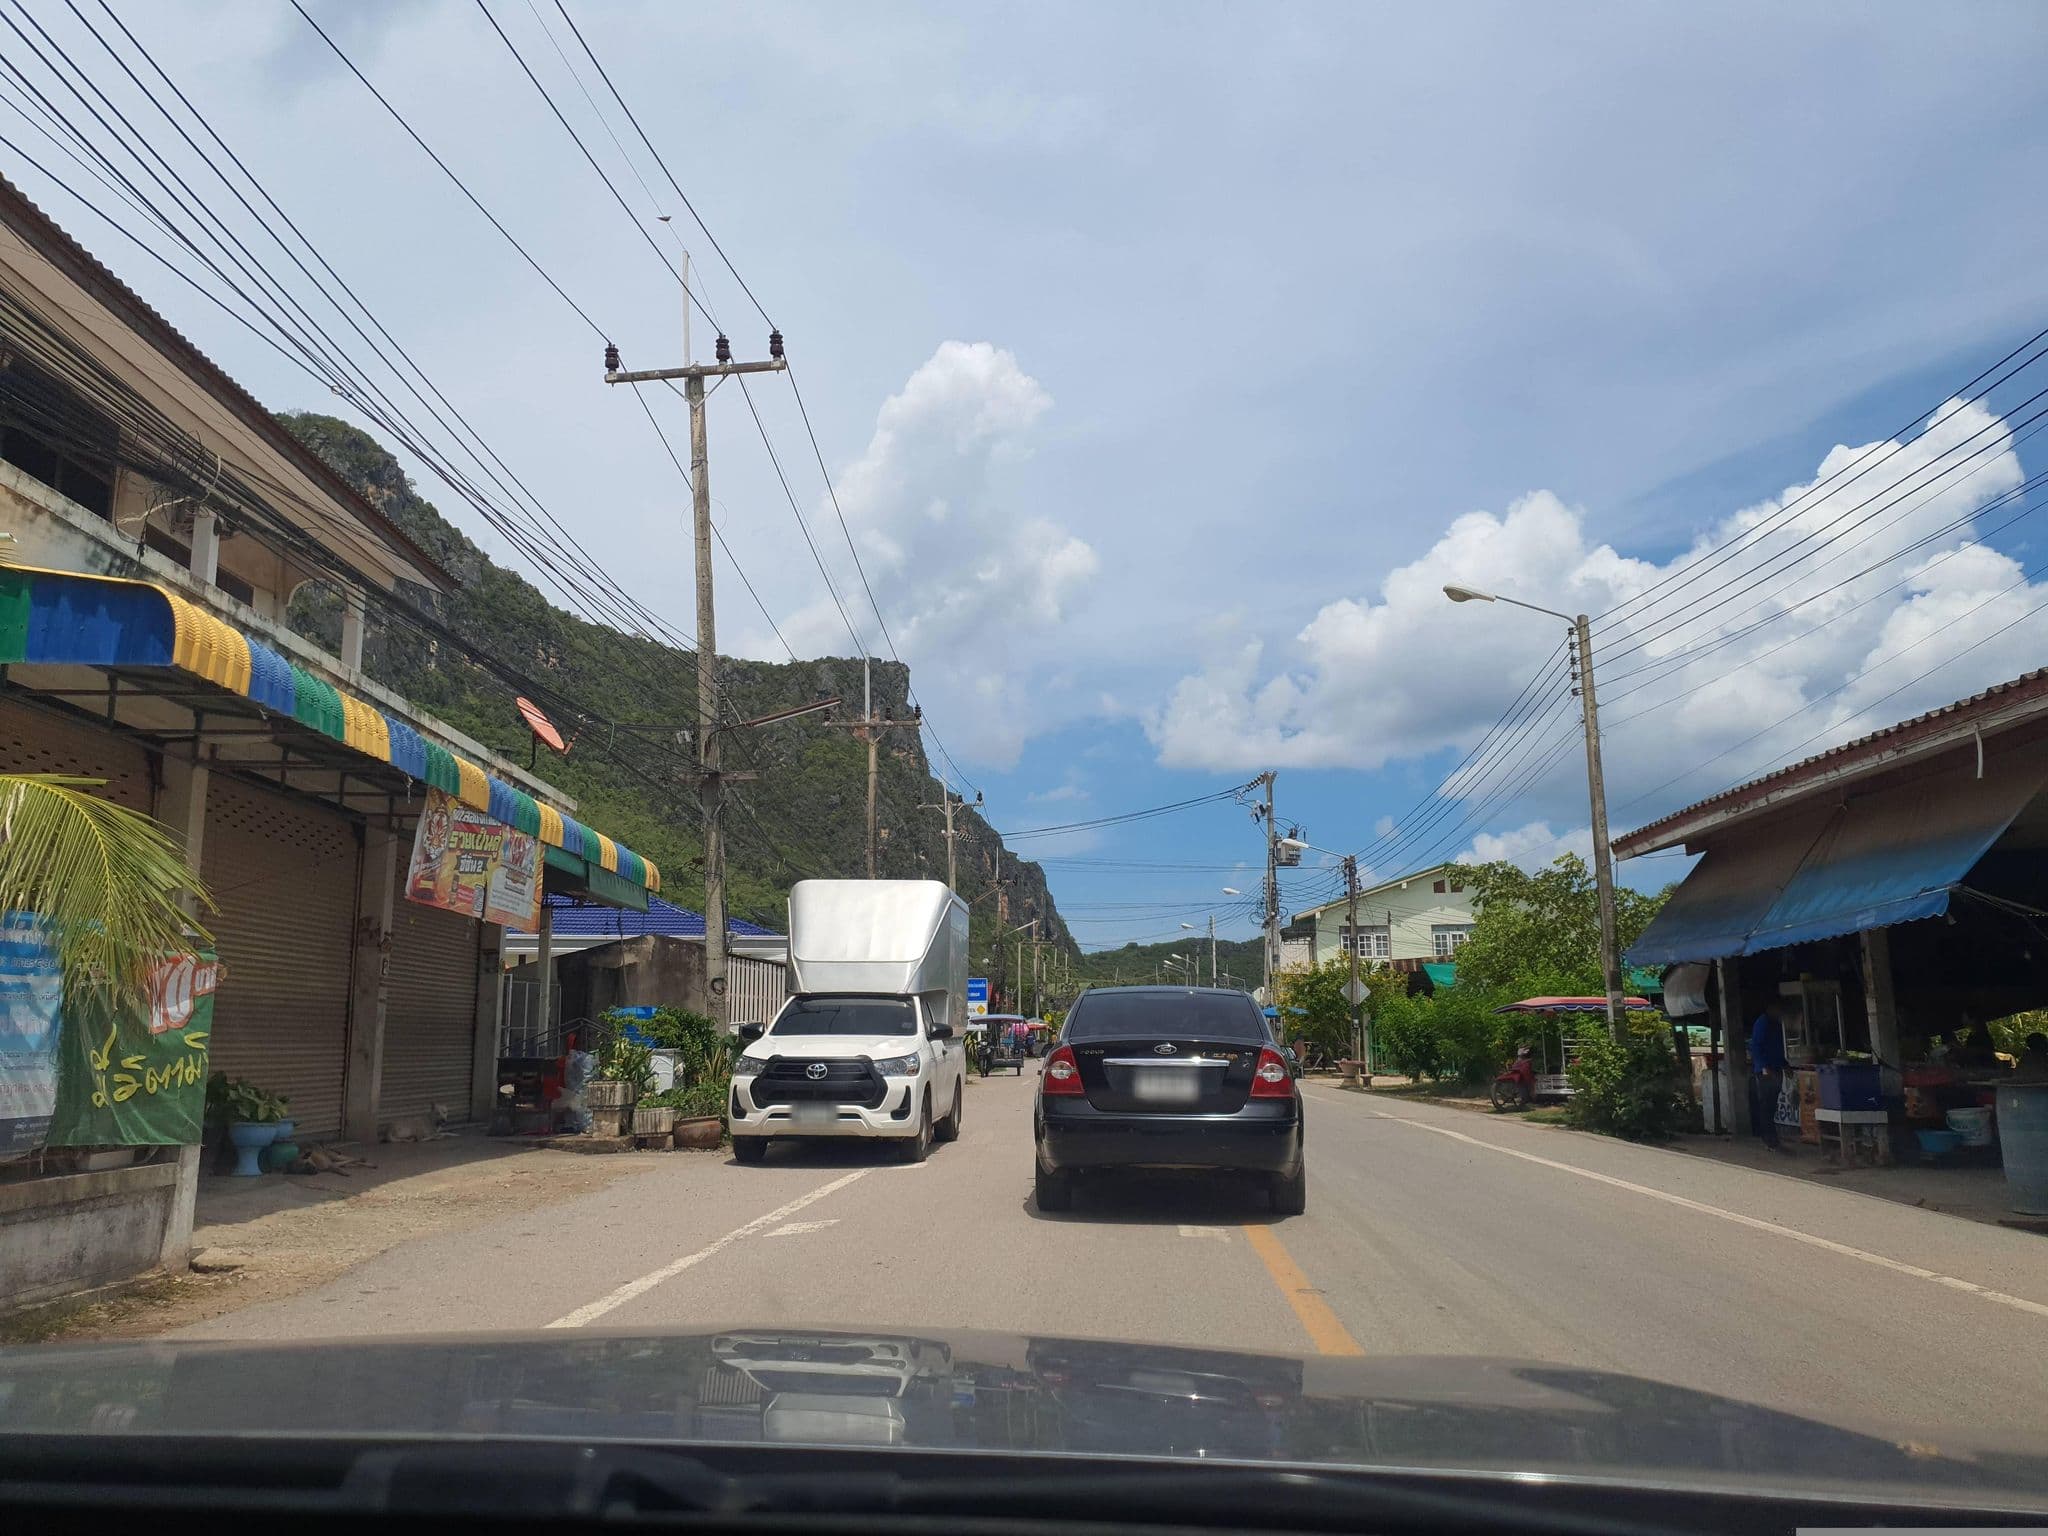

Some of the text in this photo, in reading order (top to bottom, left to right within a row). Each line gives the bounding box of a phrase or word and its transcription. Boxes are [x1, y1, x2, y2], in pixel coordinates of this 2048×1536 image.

[476, 860, 484, 873] 2
[90, 1022, 208, 1109] มีวิตามิ
